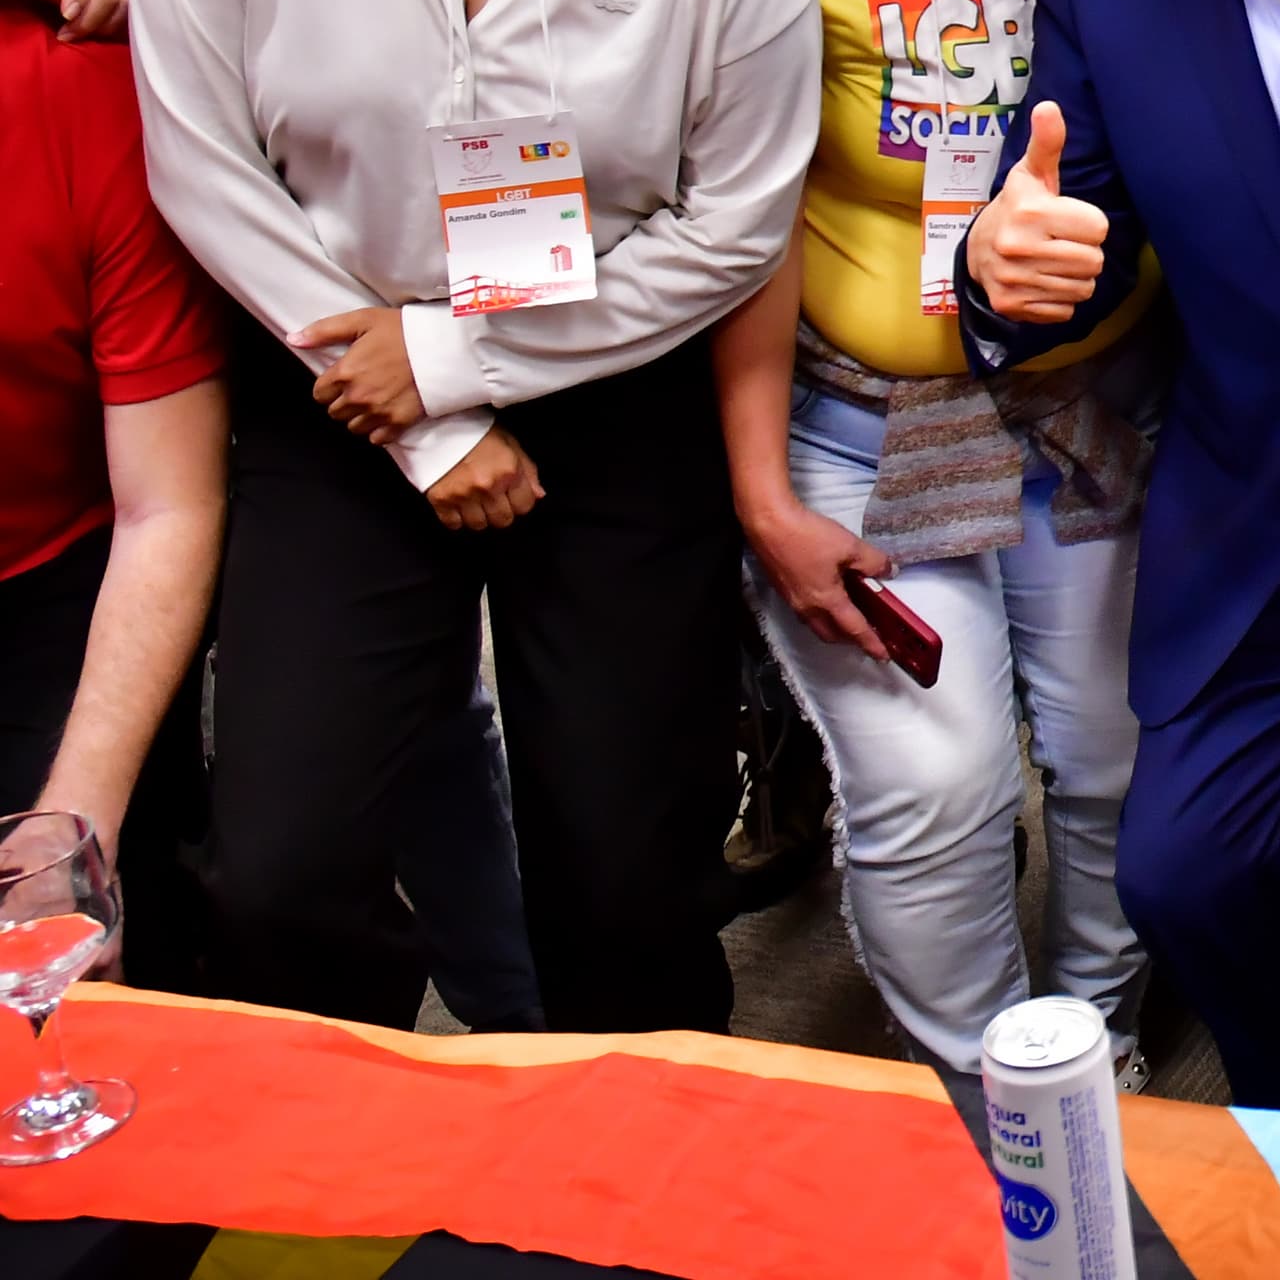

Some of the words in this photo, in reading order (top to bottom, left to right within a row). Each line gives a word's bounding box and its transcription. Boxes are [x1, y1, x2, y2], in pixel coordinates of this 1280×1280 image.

[888, 105, 1016, 149] SOCIA
[461, 140, 489, 152] PSB
[953, 154, 976, 164] PSB
[496, 188, 532, 202] LGBT
[448, 212, 487, 224] Amanda
[488, 207, 527, 219] Gondim
